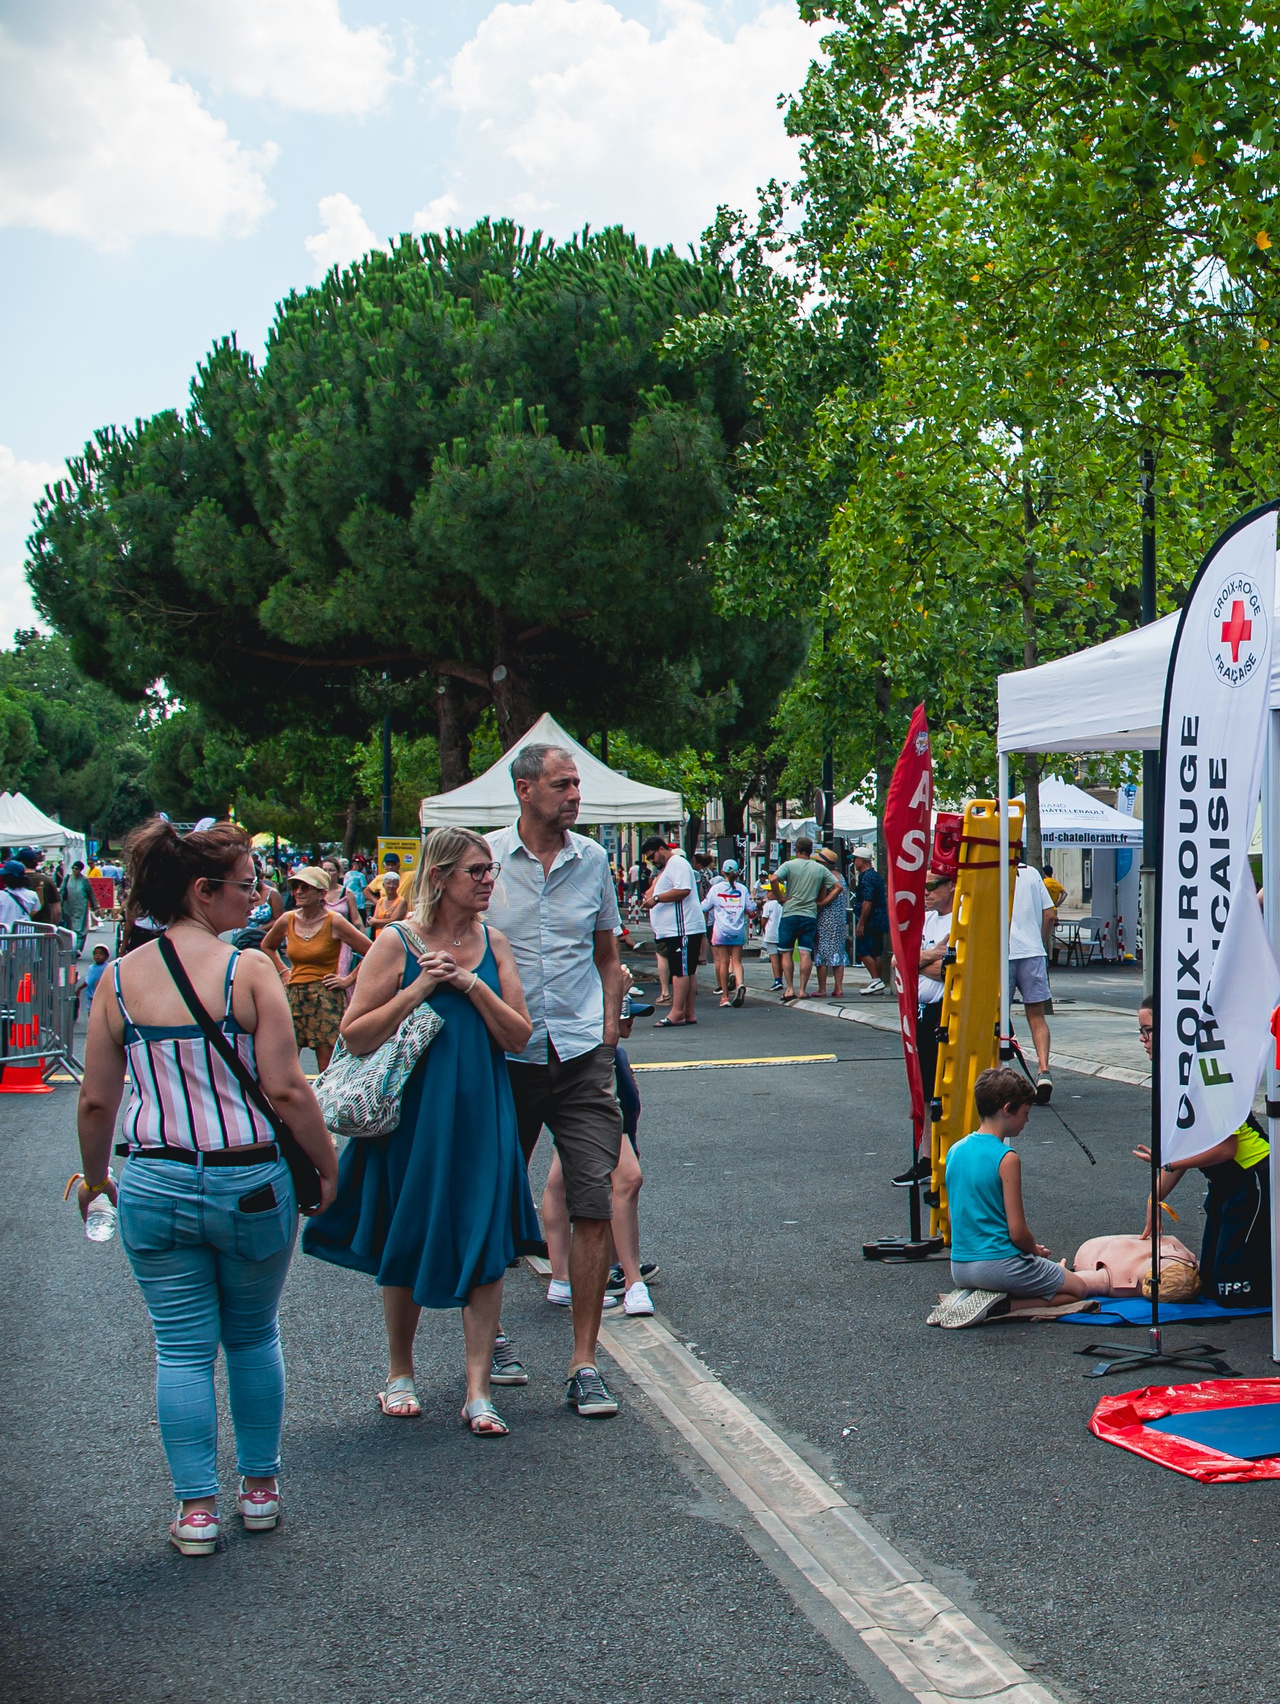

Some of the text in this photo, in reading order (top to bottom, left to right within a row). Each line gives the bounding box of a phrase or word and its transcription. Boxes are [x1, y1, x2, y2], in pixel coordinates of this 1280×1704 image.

[1213, 579, 1261, 618] CROIX-ROGE
[1215, 652, 1257, 685] FRAÇAISE
[1040, 807, 1105, 815] HÂTELLERAULT
[1040, 832, 1129, 843] nd-chatellerault.fr
